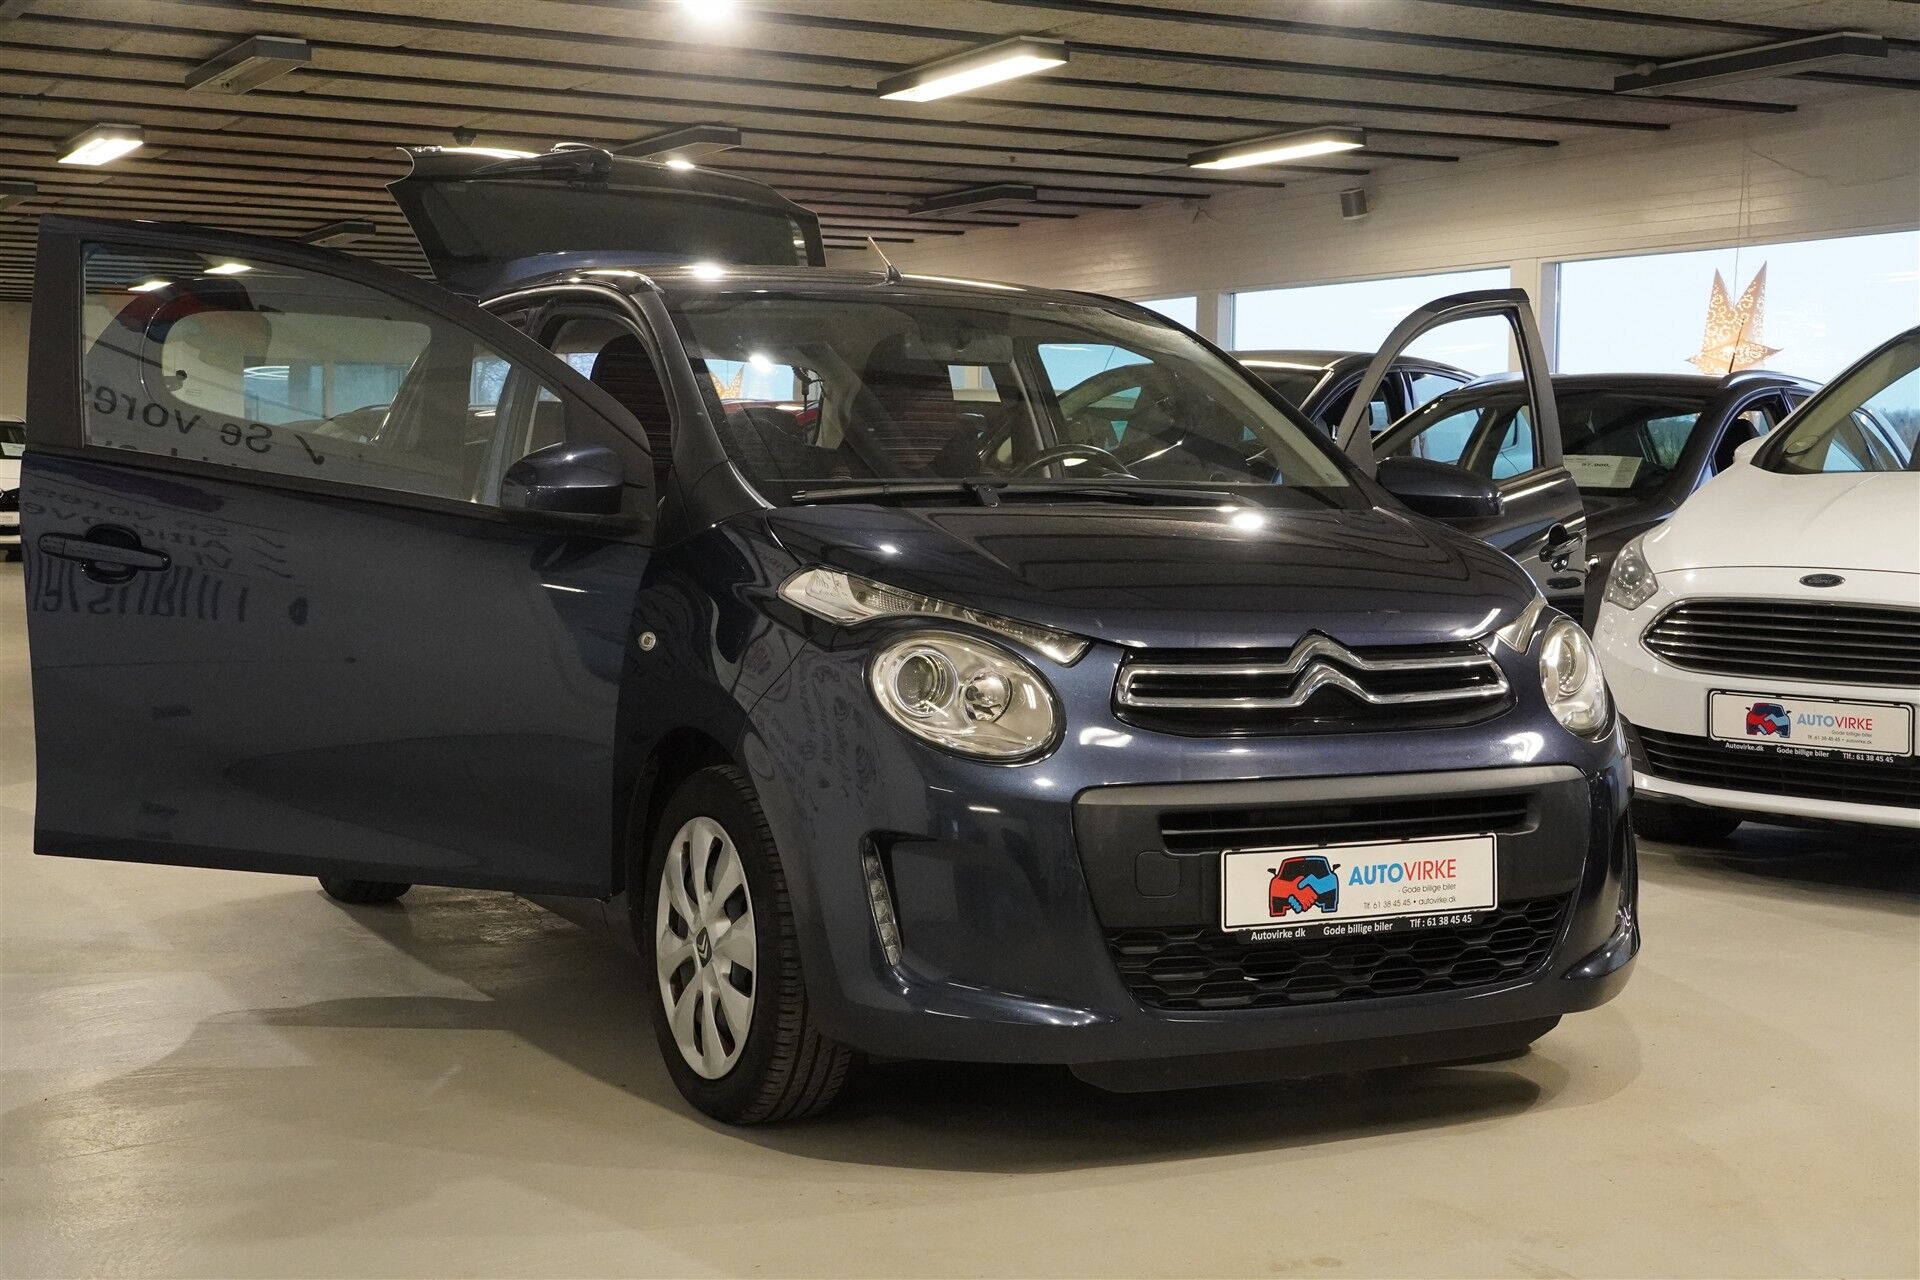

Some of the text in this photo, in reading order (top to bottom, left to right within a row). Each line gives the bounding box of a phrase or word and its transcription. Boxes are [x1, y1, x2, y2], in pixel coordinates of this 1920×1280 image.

[1796, 713, 1873, 731] AUTOVIRKE
[1776, 747, 1793, 755] Gode
[1794, 747, 1813, 757] billige
[1814, 749, 1829, 758] biler
[1856, 753, 1865, 761] 61
[1866, 754, 1874, 762] 38
[1885, 755, 1894, 763] 45
[1348, 859, 1457, 886] AUTOVIRKE
[1402, 883, 1456, 894] Gode billige biler
[1323, 925, 1346, 936] Gode
[1347, 922, 1373, 934] billige
[1374, 921, 1393, 932] biler
[1426, 917, 1437, 926] 61
[1438, 916, 1449, 926] 38
[1450, 915, 1460, 924] 45
[1462, 914, 1473, 923] 45
